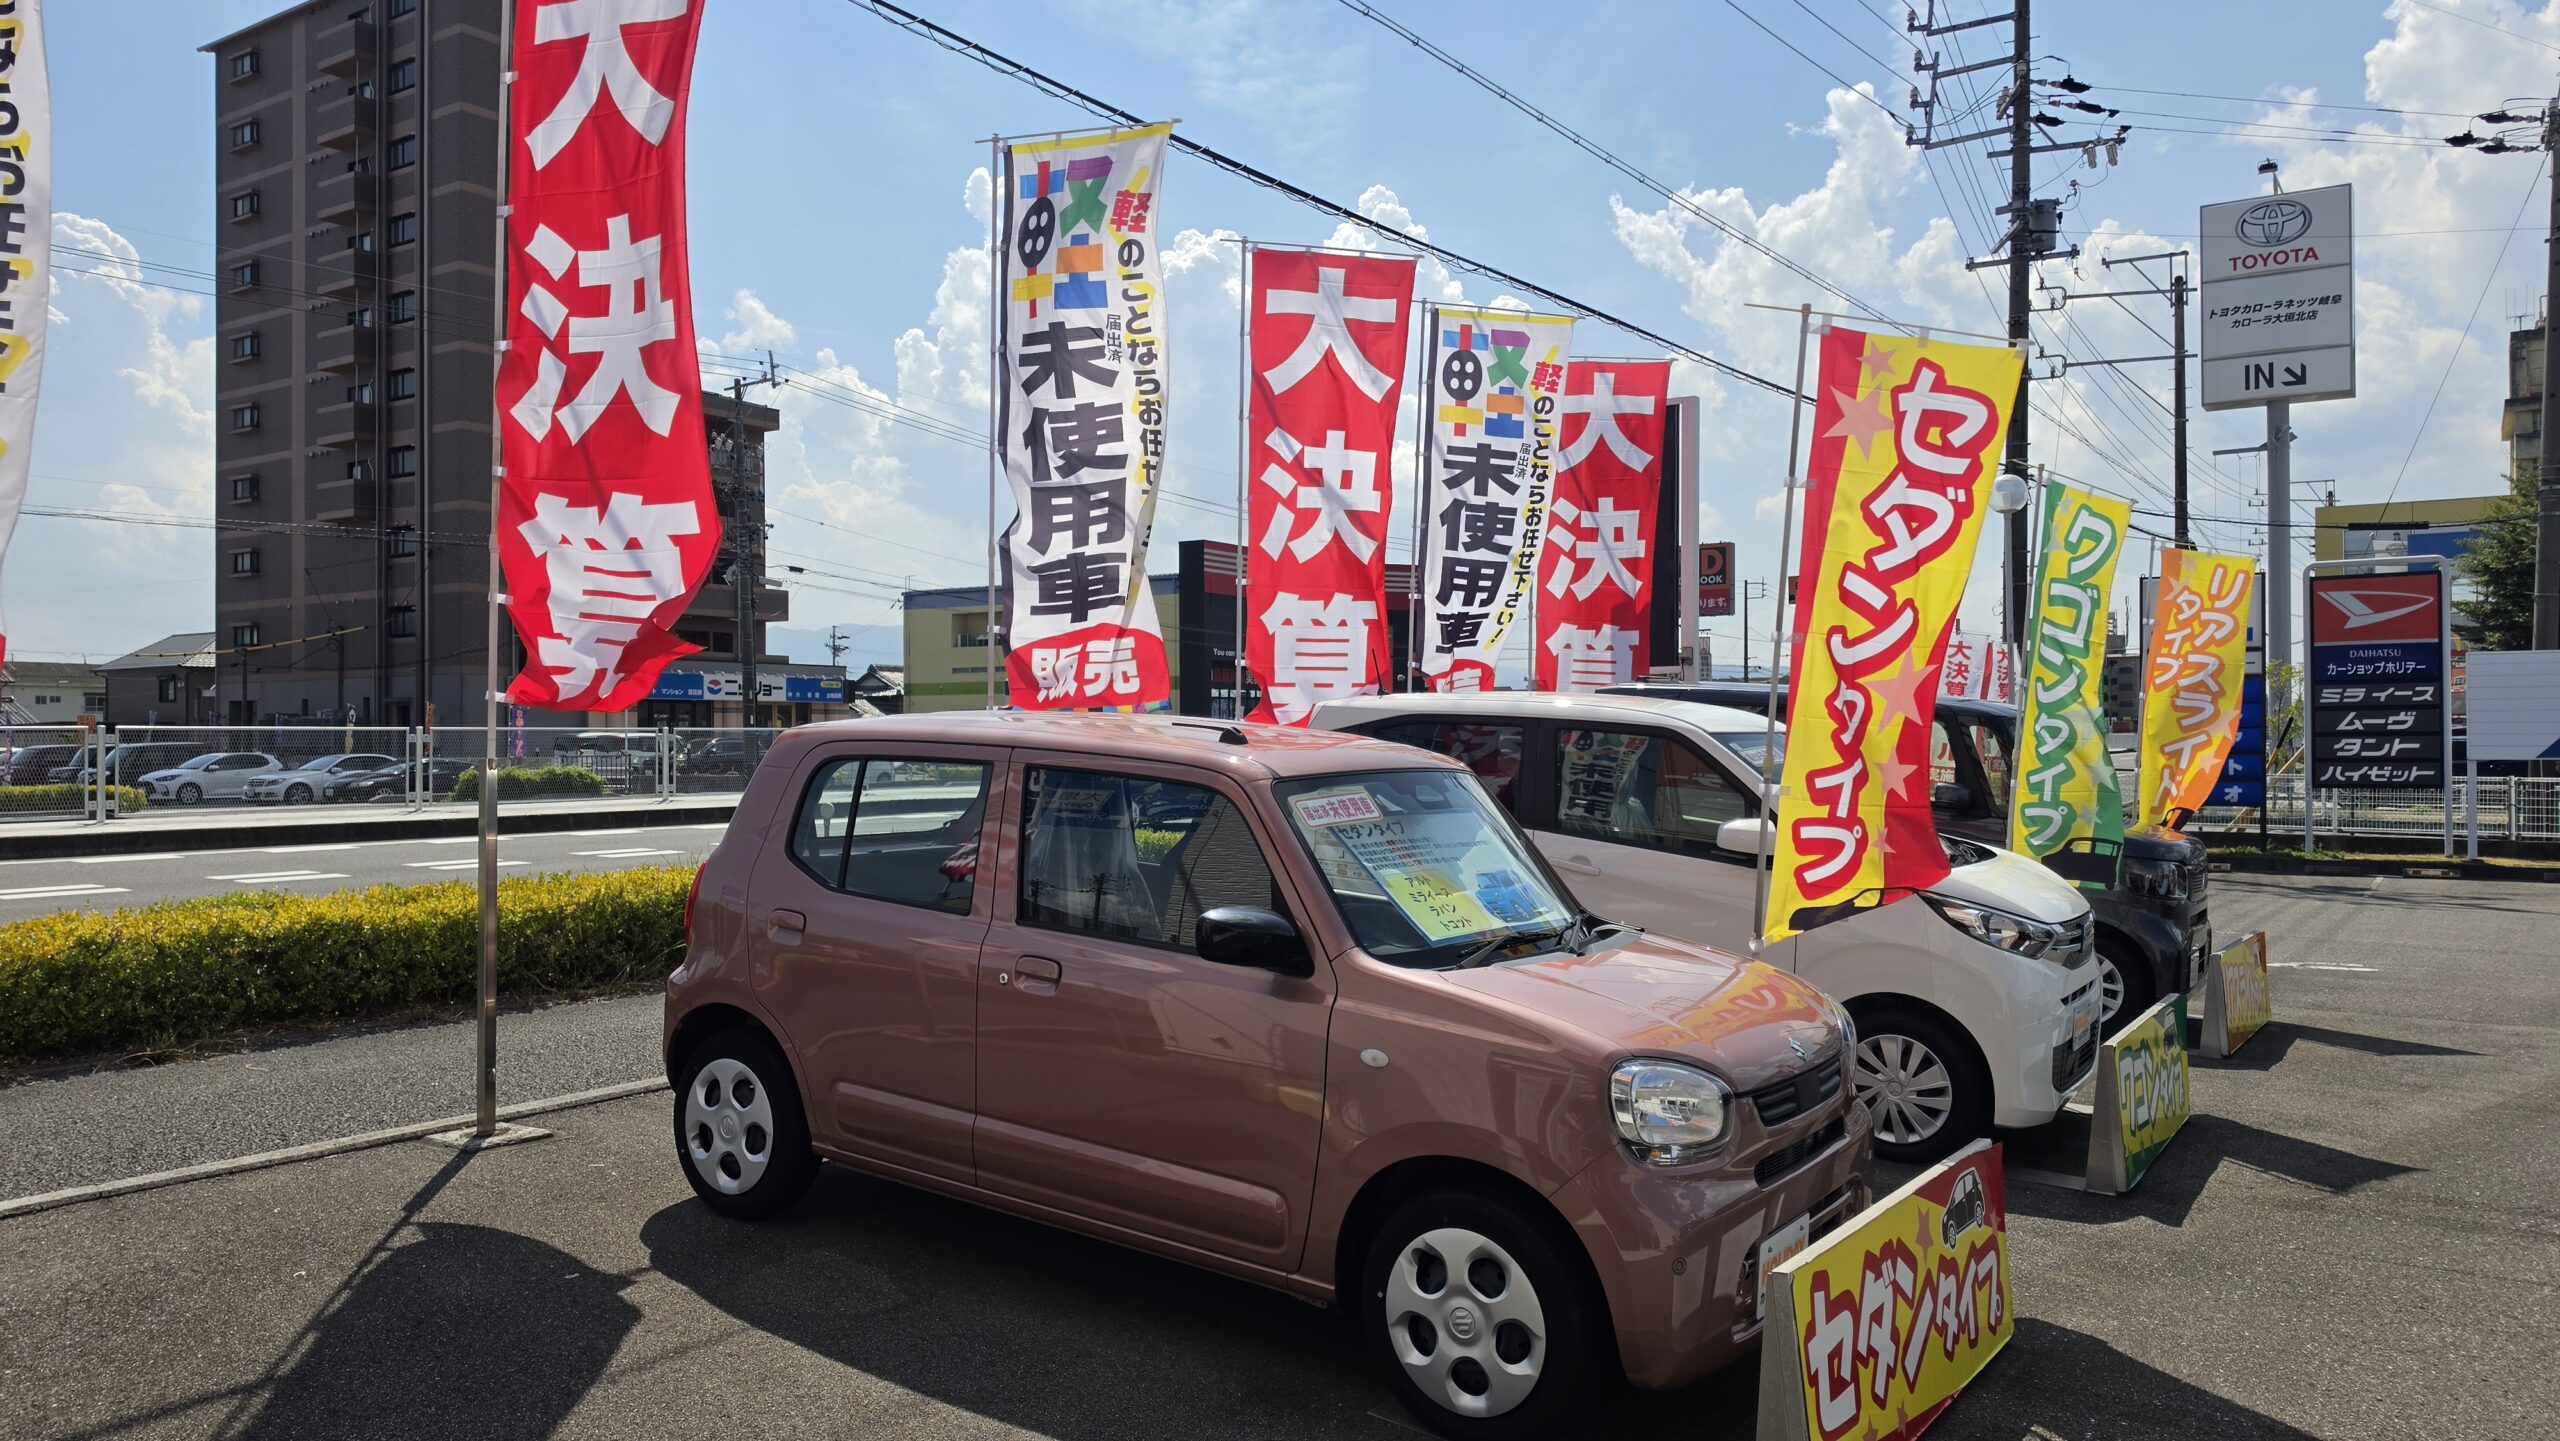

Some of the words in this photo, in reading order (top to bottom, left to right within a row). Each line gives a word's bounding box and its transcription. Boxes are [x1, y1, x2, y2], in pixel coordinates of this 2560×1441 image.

[2229, 247, 2319, 271] TOYOTA
[2209, 295, 2342, 319] トヨタカローラネッツ岐阜
[2231, 311, 2318, 328] カローラ大垣北店
[510, 0, 700, 700] 大決算
[1105, 314, 1121, 363] 届出済
[2245, 362, 2274, 390] IN
[1515, 442, 1531, 479] 届出済
[1259, 266, 1398, 725] 大決算
[1435, 443, 1521, 654] 未使用車
[1545, 372, 1655, 693] 大決算
[1699, 575, 1723, 584] OOK
[1800, 366, 1988, 883] セダンタイプ
[2155, 590, 2201, 685] タイプ
[1031, 636, 1139, 703] 販売
[1945, 641, 1972, 696] 大決算
[2025, 510, 2112, 845] ワゴンタイプ
[2327, 661, 2427, 676] カーショップホリデー
[2350, 649, 2401, 658] DAIHATSU
[2153, 567, 2244, 807] リアスライド
[2336, 711, 2417, 731] ムーヴ
[2333, 738, 2421, 757] タント
[2319, 766, 2435, 782] ハイゼット
[1808, 1250, 2001, 1432] セダンタイプ
